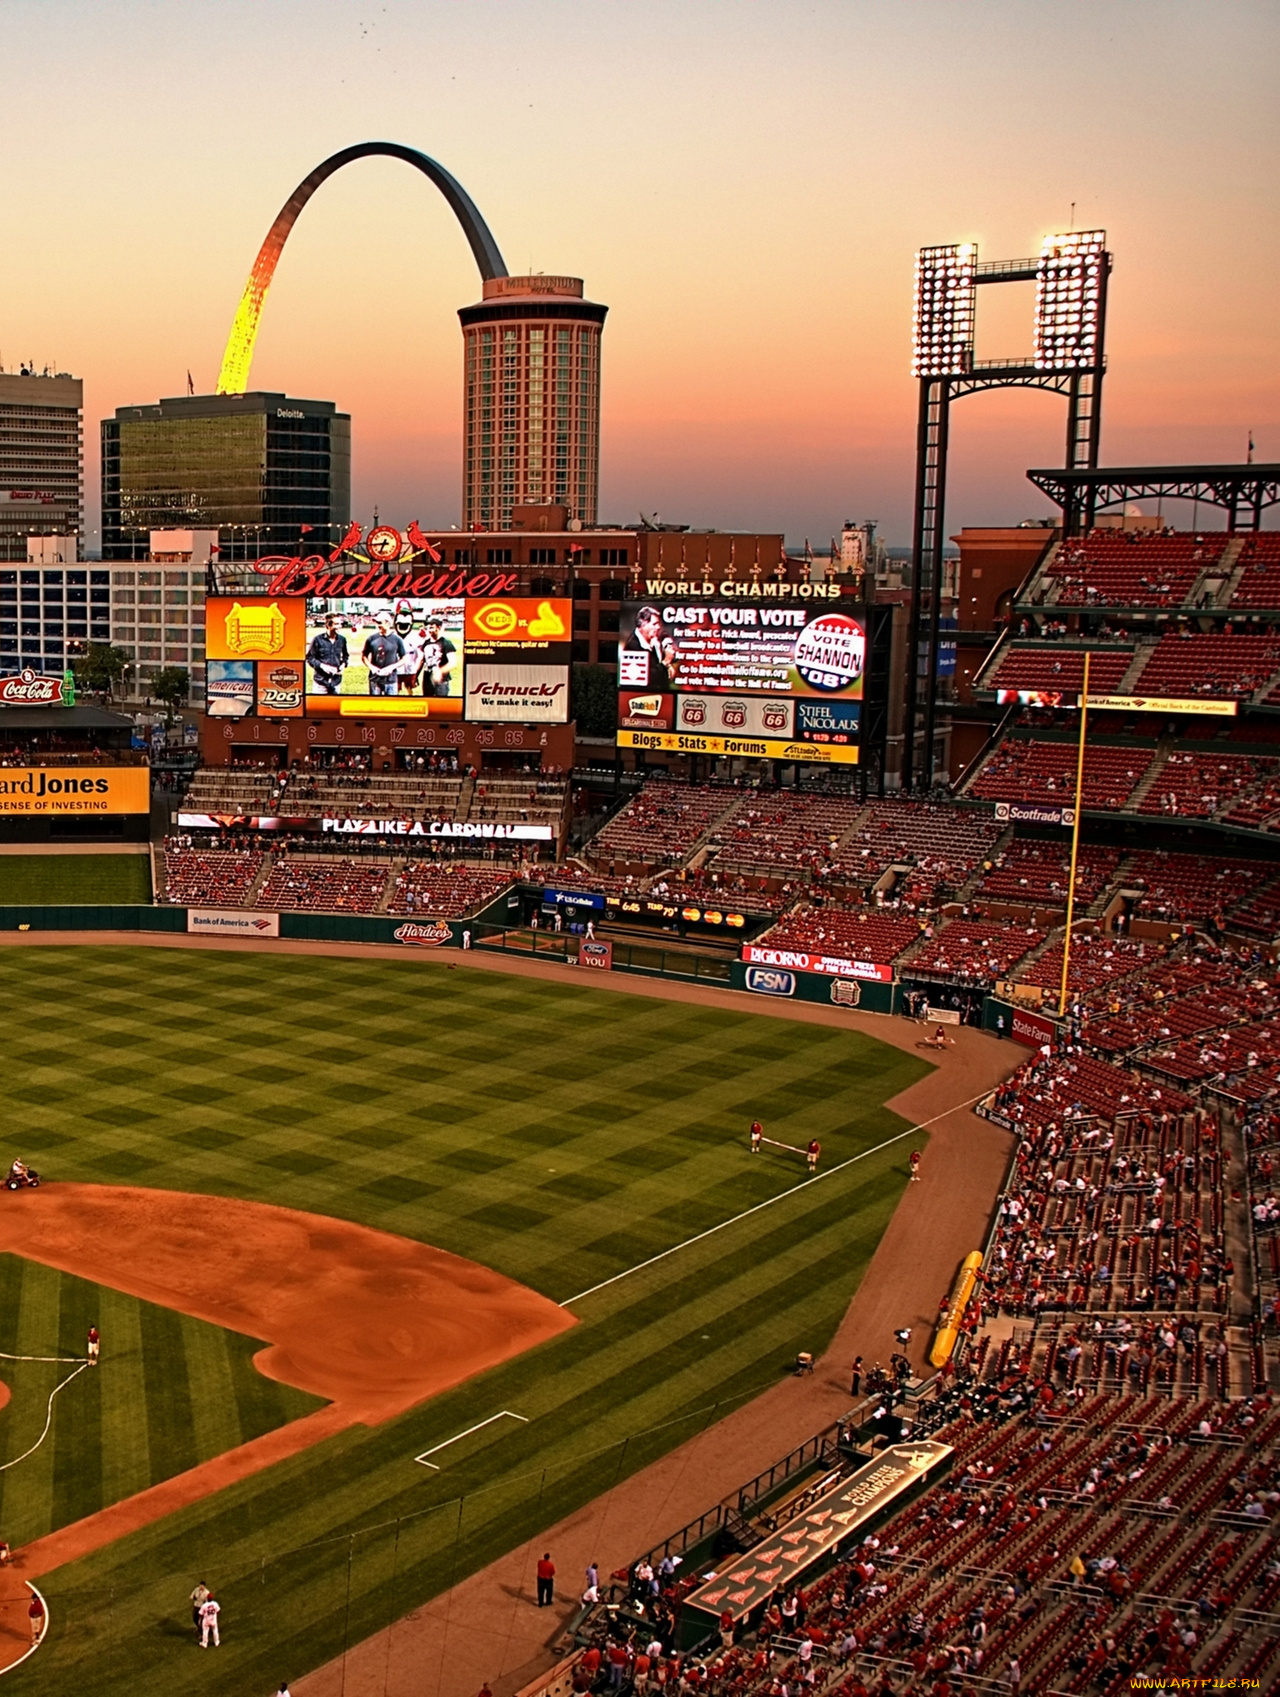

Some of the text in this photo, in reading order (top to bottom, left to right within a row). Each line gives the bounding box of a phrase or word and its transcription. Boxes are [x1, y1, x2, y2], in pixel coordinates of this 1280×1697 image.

[254, 555, 518, 596] Budweiser
[646, 580, 841, 597] WORLD CHAMPIONS
[662, 607, 807, 627] CAST YOUR VOTE
[707, 641, 715, 649] to
[813, 635, 851, 648] VOTE
[751, 654, 759, 662] to
[797, 644, 861, 671] SHANNON
[680, 665, 689, 674] Go
[690, 665, 698, 674] to
[469, 682, 565, 696] Schnucks
[497, 698, 520, 706] make
[530, 699, 553, 708] easy!
[1106, 699, 1131, 707] America
[685, 710, 702, 721] 66
[725, 712, 742, 723] 66
[799, 704, 833, 718] STIFEL
[766, 715, 783, 726] 66
[803, 716, 859, 730] NICOLAUS
[253, 725, 260, 738] 1
[279, 725, 289, 739] 2
[307, 726, 317, 740] 6
[335, 726, 345, 741] 9
[361, 728, 376, 742] 14
[390, 728, 405, 742] 17
[417, 728, 436, 743] 20
[446, 729, 465, 743] 42
[475, 729, 494, 744] 45
[504, 730, 523, 745] 85
[632, 733, 766, 754] Blogs Stats Forums
[36, 773, 109, 796] Jones
[1010, 807, 1060, 822] Scottrade
[322, 819, 360, 833] PLAY
[409, 822, 424, 835] A
[193, 917, 249, 927] Bank of America
[584, 957, 606, 967] YOU
[752, 971, 789, 990] FSN
[841, 1481, 870, 1501] WORLD
[852, 1467, 905, 1506] CHAMPIONS
